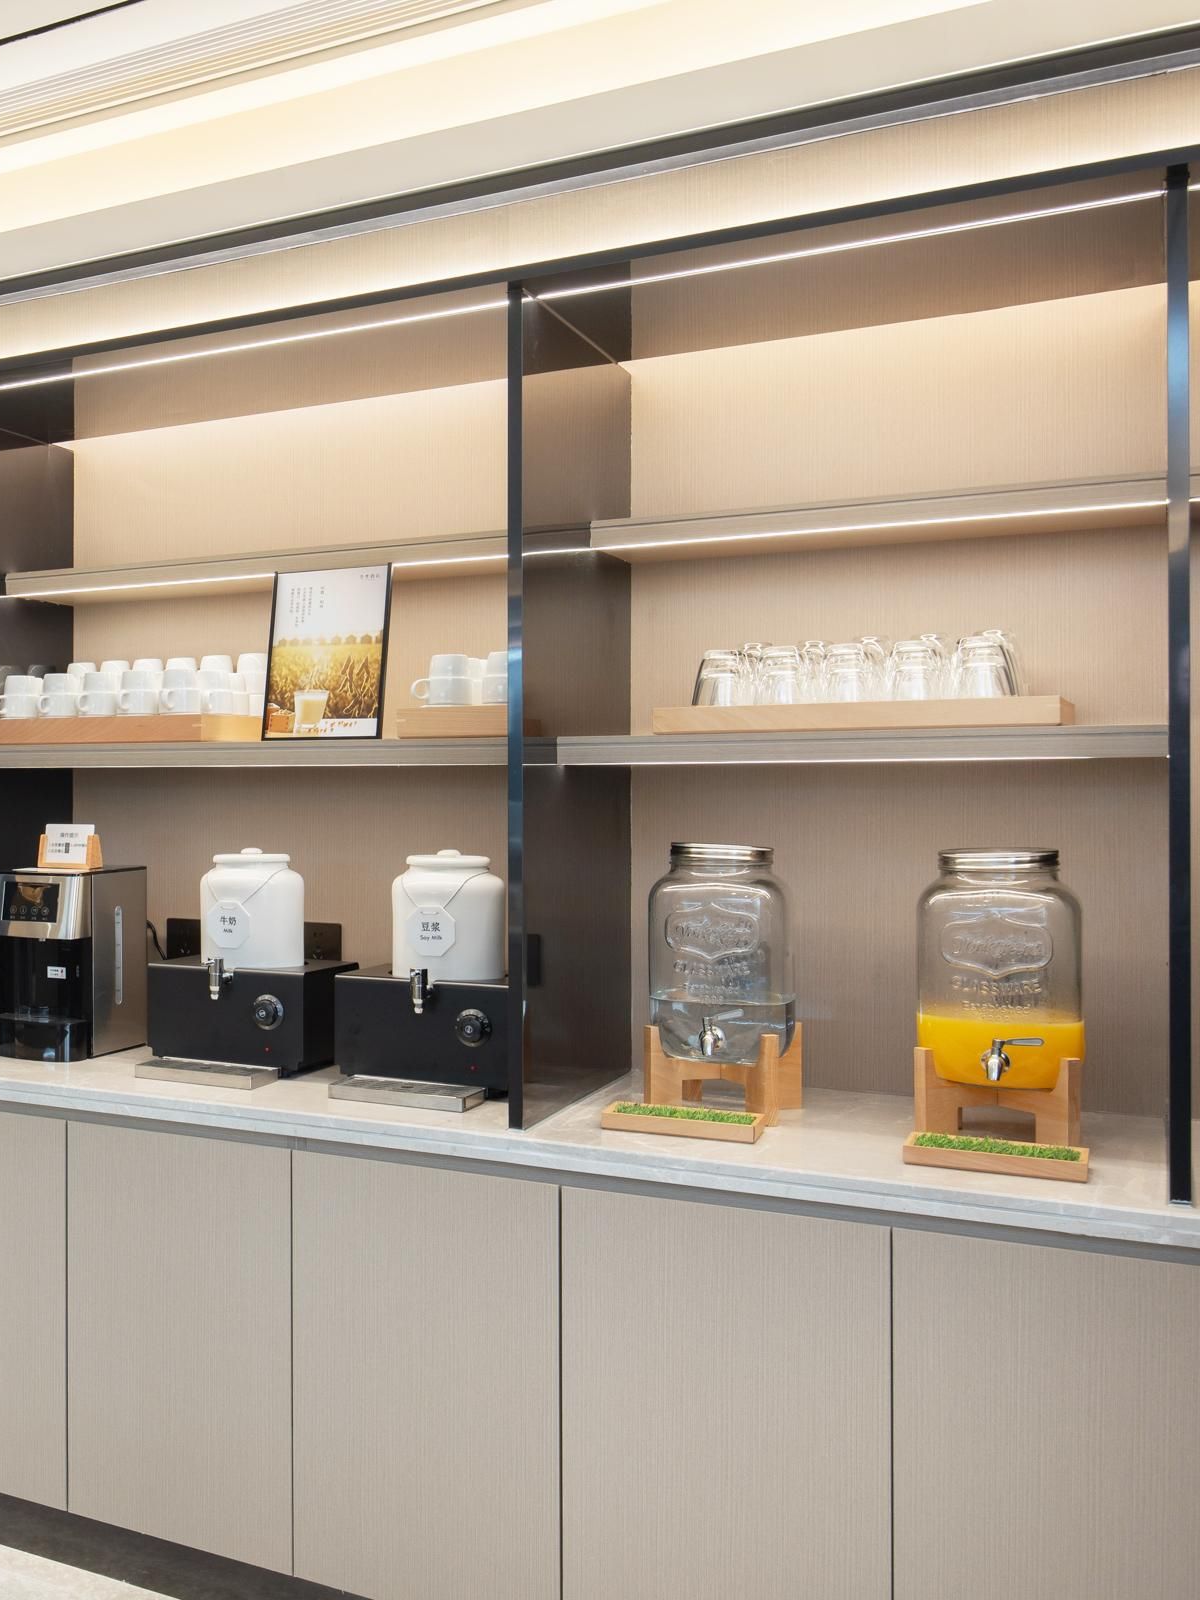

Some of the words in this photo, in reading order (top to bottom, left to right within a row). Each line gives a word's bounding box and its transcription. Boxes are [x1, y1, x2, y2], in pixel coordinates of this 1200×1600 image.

[220, 915, 237, 926] 牛奶
[421, 921, 441, 932] 豆浆
[420, 934, 430, 942] Soy
[952, 975, 1042, 995] GLASSWARE
